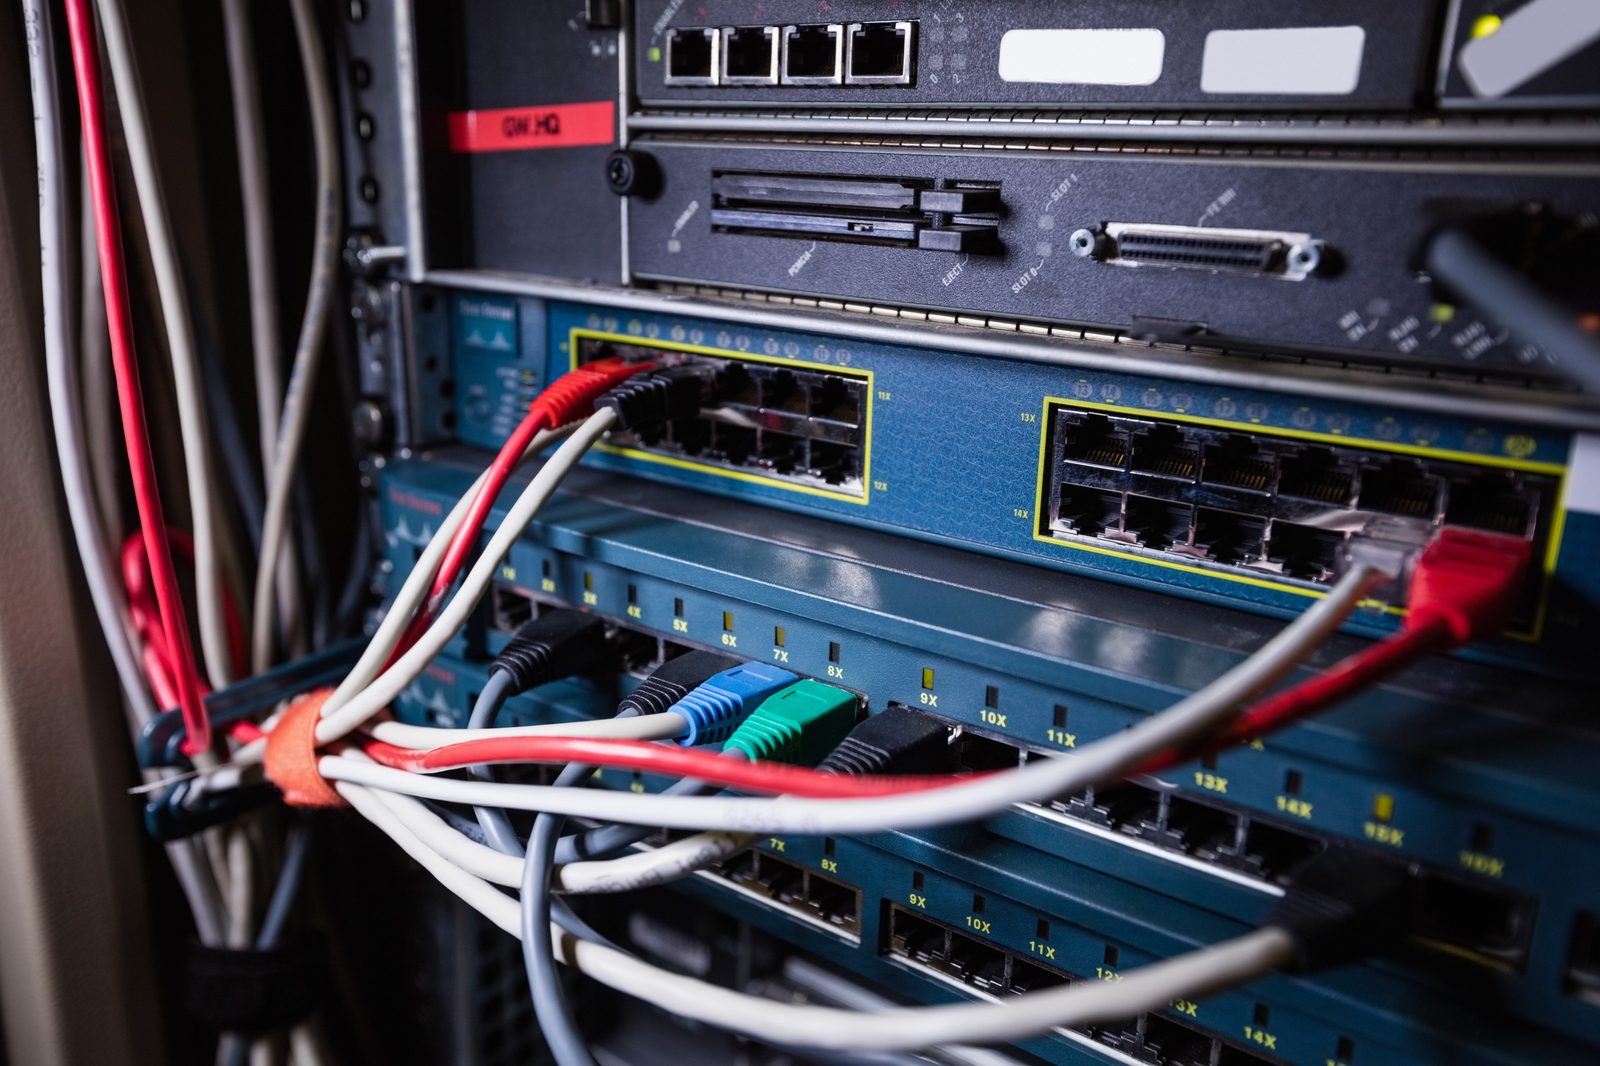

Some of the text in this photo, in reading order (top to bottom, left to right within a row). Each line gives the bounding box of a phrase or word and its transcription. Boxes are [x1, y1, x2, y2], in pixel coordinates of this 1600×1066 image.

[956, 12, 964, 23] 3
[952, 73, 961, 84] 2
[1050, 178, 1072, 202] SLOT
[942, 262, 963, 287] EJECT
[1011, 272, 1032, 294] SLOT
[1020, 412, 1036, 423] 13X
[1013, 508, 1029, 519] 14X
[627, 605, 641, 619] 4X
[672, 618, 688, 633] 5X
[721, 633, 737, 648] 6X
[772, 648, 789, 663] 7X
[827, 665, 844, 680] 8X
[919, 692, 939, 707] 9X
[979, 709, 1007, 728] 10X
[1046, 729, 1077, 749] 11X
[770, 838, 785, 852] 7X
[821, 858, 837, 873] 8X
[909, 893, 926, 909] 9X
[966, 916, 991, 934] 10X
[1029, 940, 1055, 960] 11X
[1243, 1026, 1277, 1050] 14X
